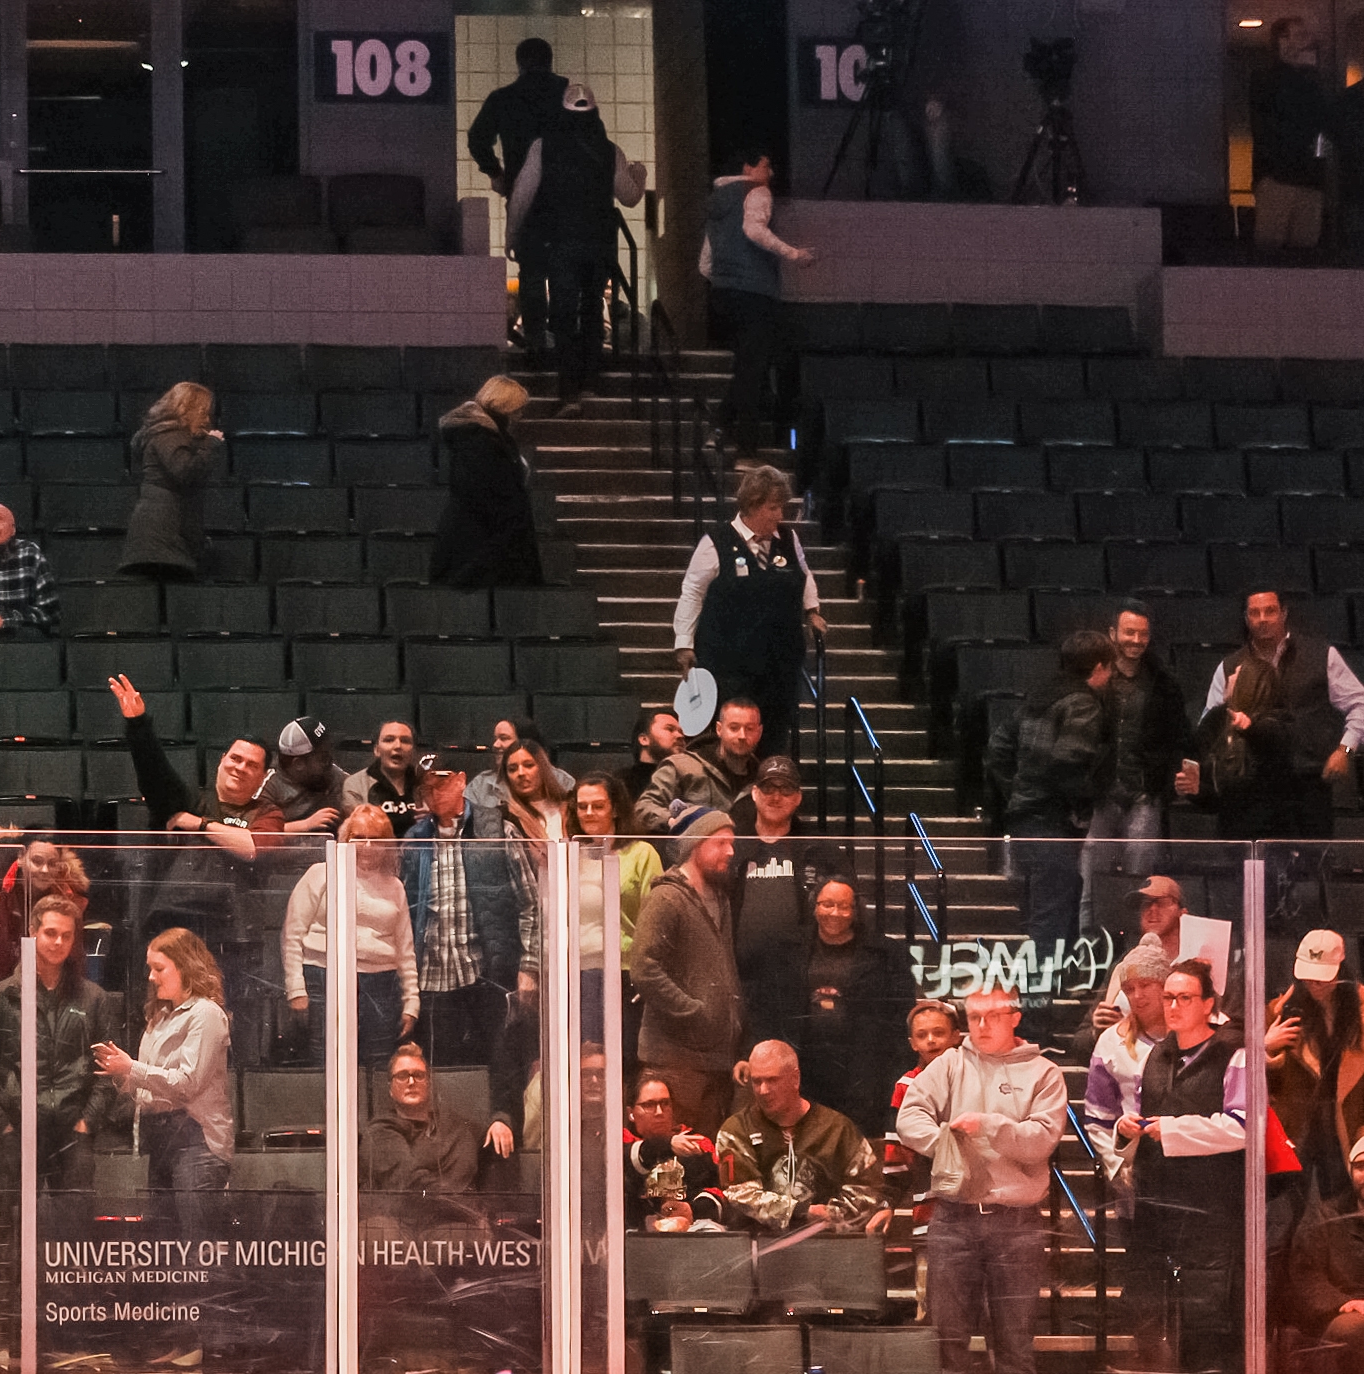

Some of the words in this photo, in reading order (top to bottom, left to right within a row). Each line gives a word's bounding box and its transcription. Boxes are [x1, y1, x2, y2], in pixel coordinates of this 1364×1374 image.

[331, 38, 432, 97] 108
[815, 44, 868, 102] 10
[44, 1240, 192, 1267] UNIVERSITY
[198, 1240, 229, 1267] OF
[234, 1240, 365, 1267] MICHIG
[373, 1240, 545, 1267] HEALTH-WEST
[45, 1270, 127, 1284] MICHIGAN
[132, 1270, 209, 1284] MEDICINE
[45, 1301, 107, 1326] Sports
[114, 1301, 201, 1323] Medicine
